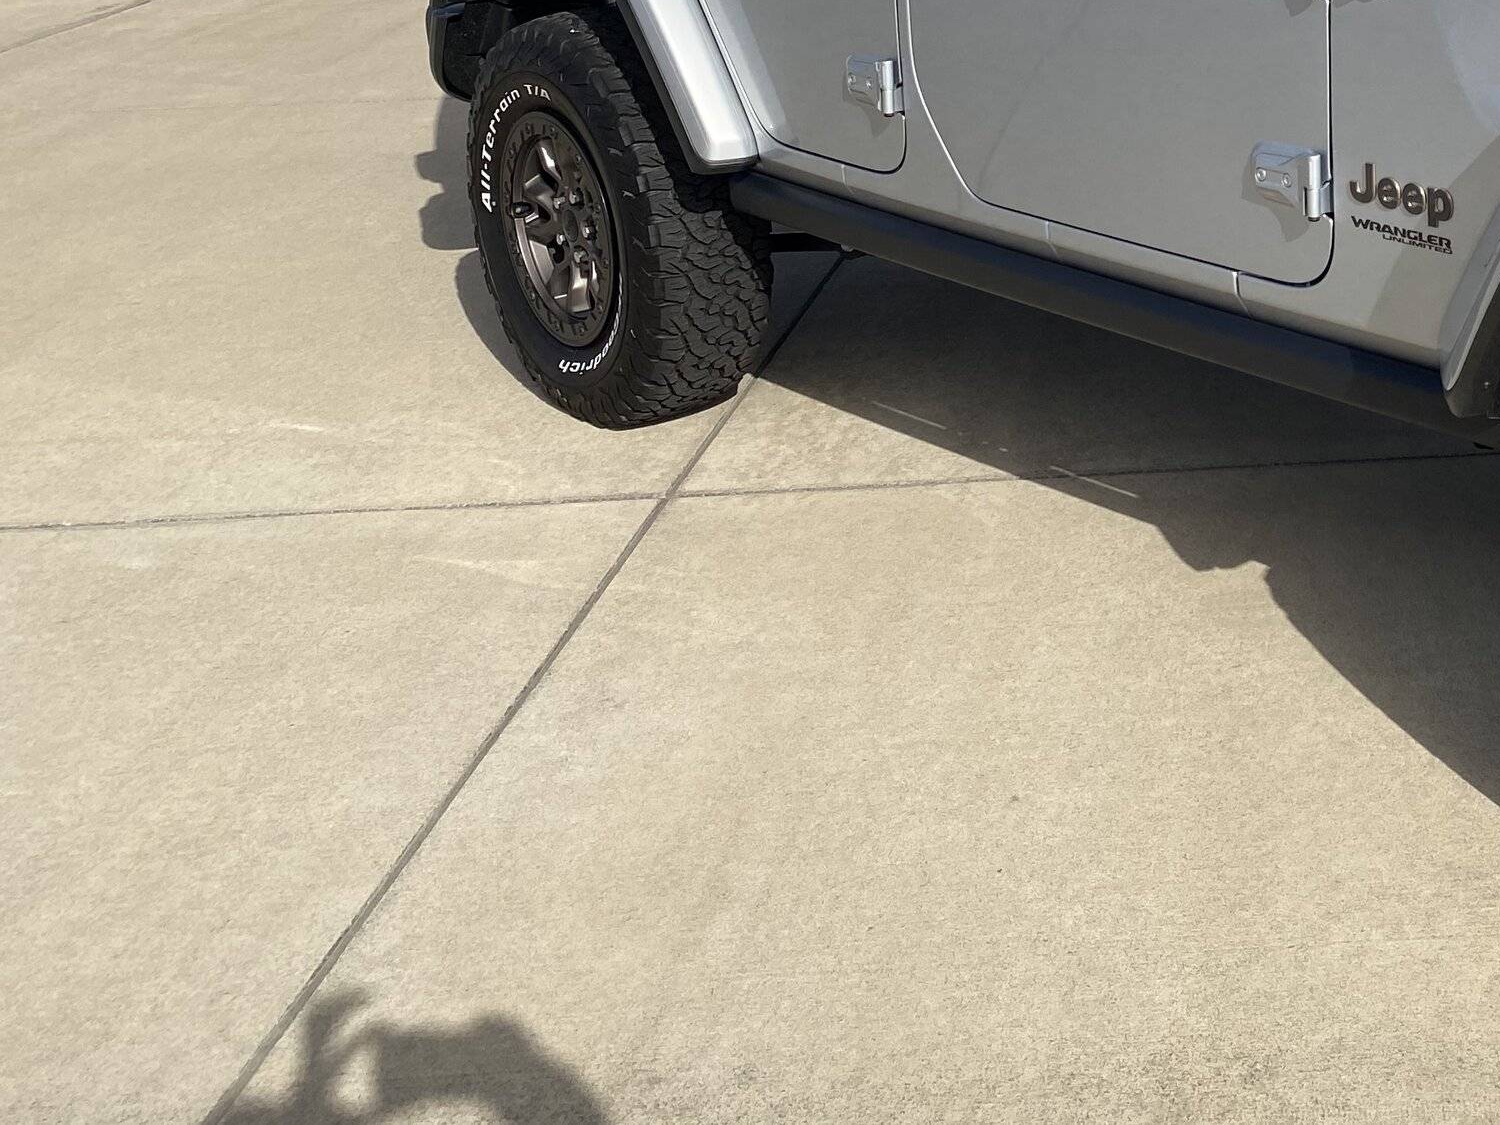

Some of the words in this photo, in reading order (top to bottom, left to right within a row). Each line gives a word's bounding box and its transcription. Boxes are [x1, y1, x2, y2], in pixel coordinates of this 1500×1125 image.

[481, 87, 521, 213] All-Terrain
[523, 83, 551, 103] T/A
[1349, 162, 1455, 229] Jeep
[1350, 215, 1452, 250] WRANGLER
[1382, 233, 1454, 255] UNLIMITED
